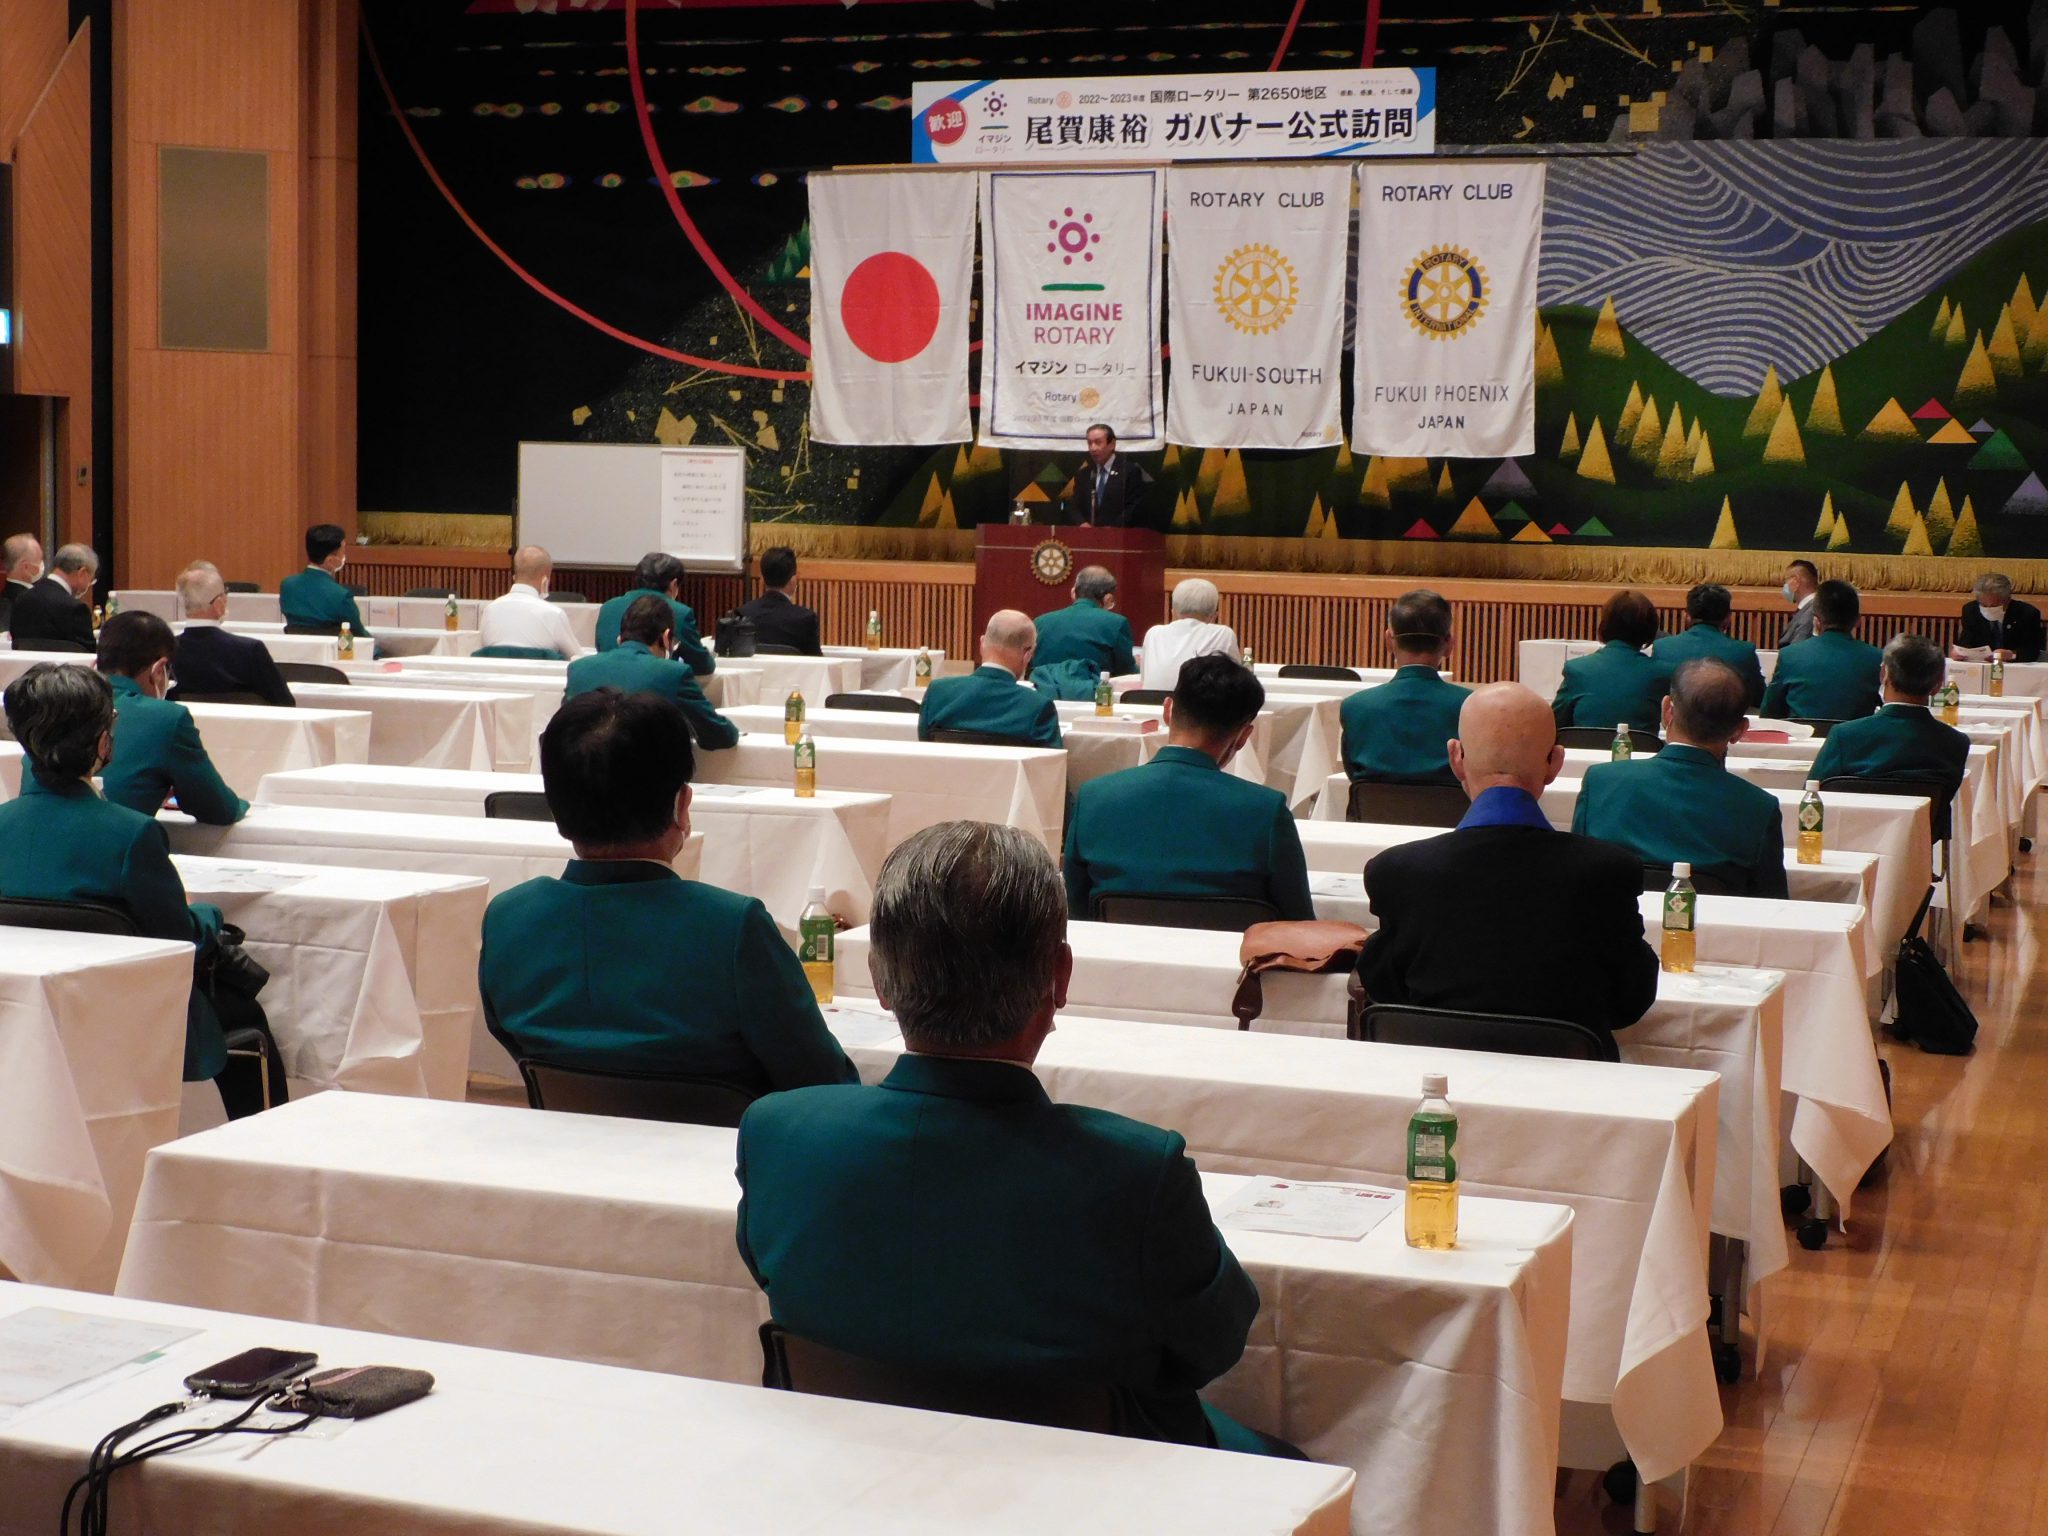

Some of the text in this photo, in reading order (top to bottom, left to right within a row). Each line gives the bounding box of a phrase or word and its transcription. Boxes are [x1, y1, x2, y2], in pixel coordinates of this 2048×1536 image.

[1027, 96, 1054, 106] Rotary
[1150, 89, 1240, 103] 国際ロータリー
[1247, 86, 1328, 101] 第2650地区
[928, 111, 964, 132] 歓迎
[1025, 107, 1413, 144] 尾賀康裕 ガバナー公式訪問
[978, 134, 1011, 144] イマジン
[1190, 191, 1325, 207] ROTARY CLUB
[1382, 183, 1513, 202] ROTARY CLUB
[1423, 253, 1467, 270] ROTARY
[1026, 303, 1123, 321] IMAGINE
[1411, 306, 1475, 331] INTERNATIONAL
[1034, 326, 1115, 344] ROTARY
[1015, 360, 1137, 376] イマジン ロータリー
[1192, 365, 1322, 385] FUKUI-SOUTH
[1045, 392, 1077, 402] Rotary
[1375, 385, 1510, 402] FUKUI PHOENIX
[1228, 403, 1283, 416] JAPAN
[1418, 415, 1465, 429] JAPAN
